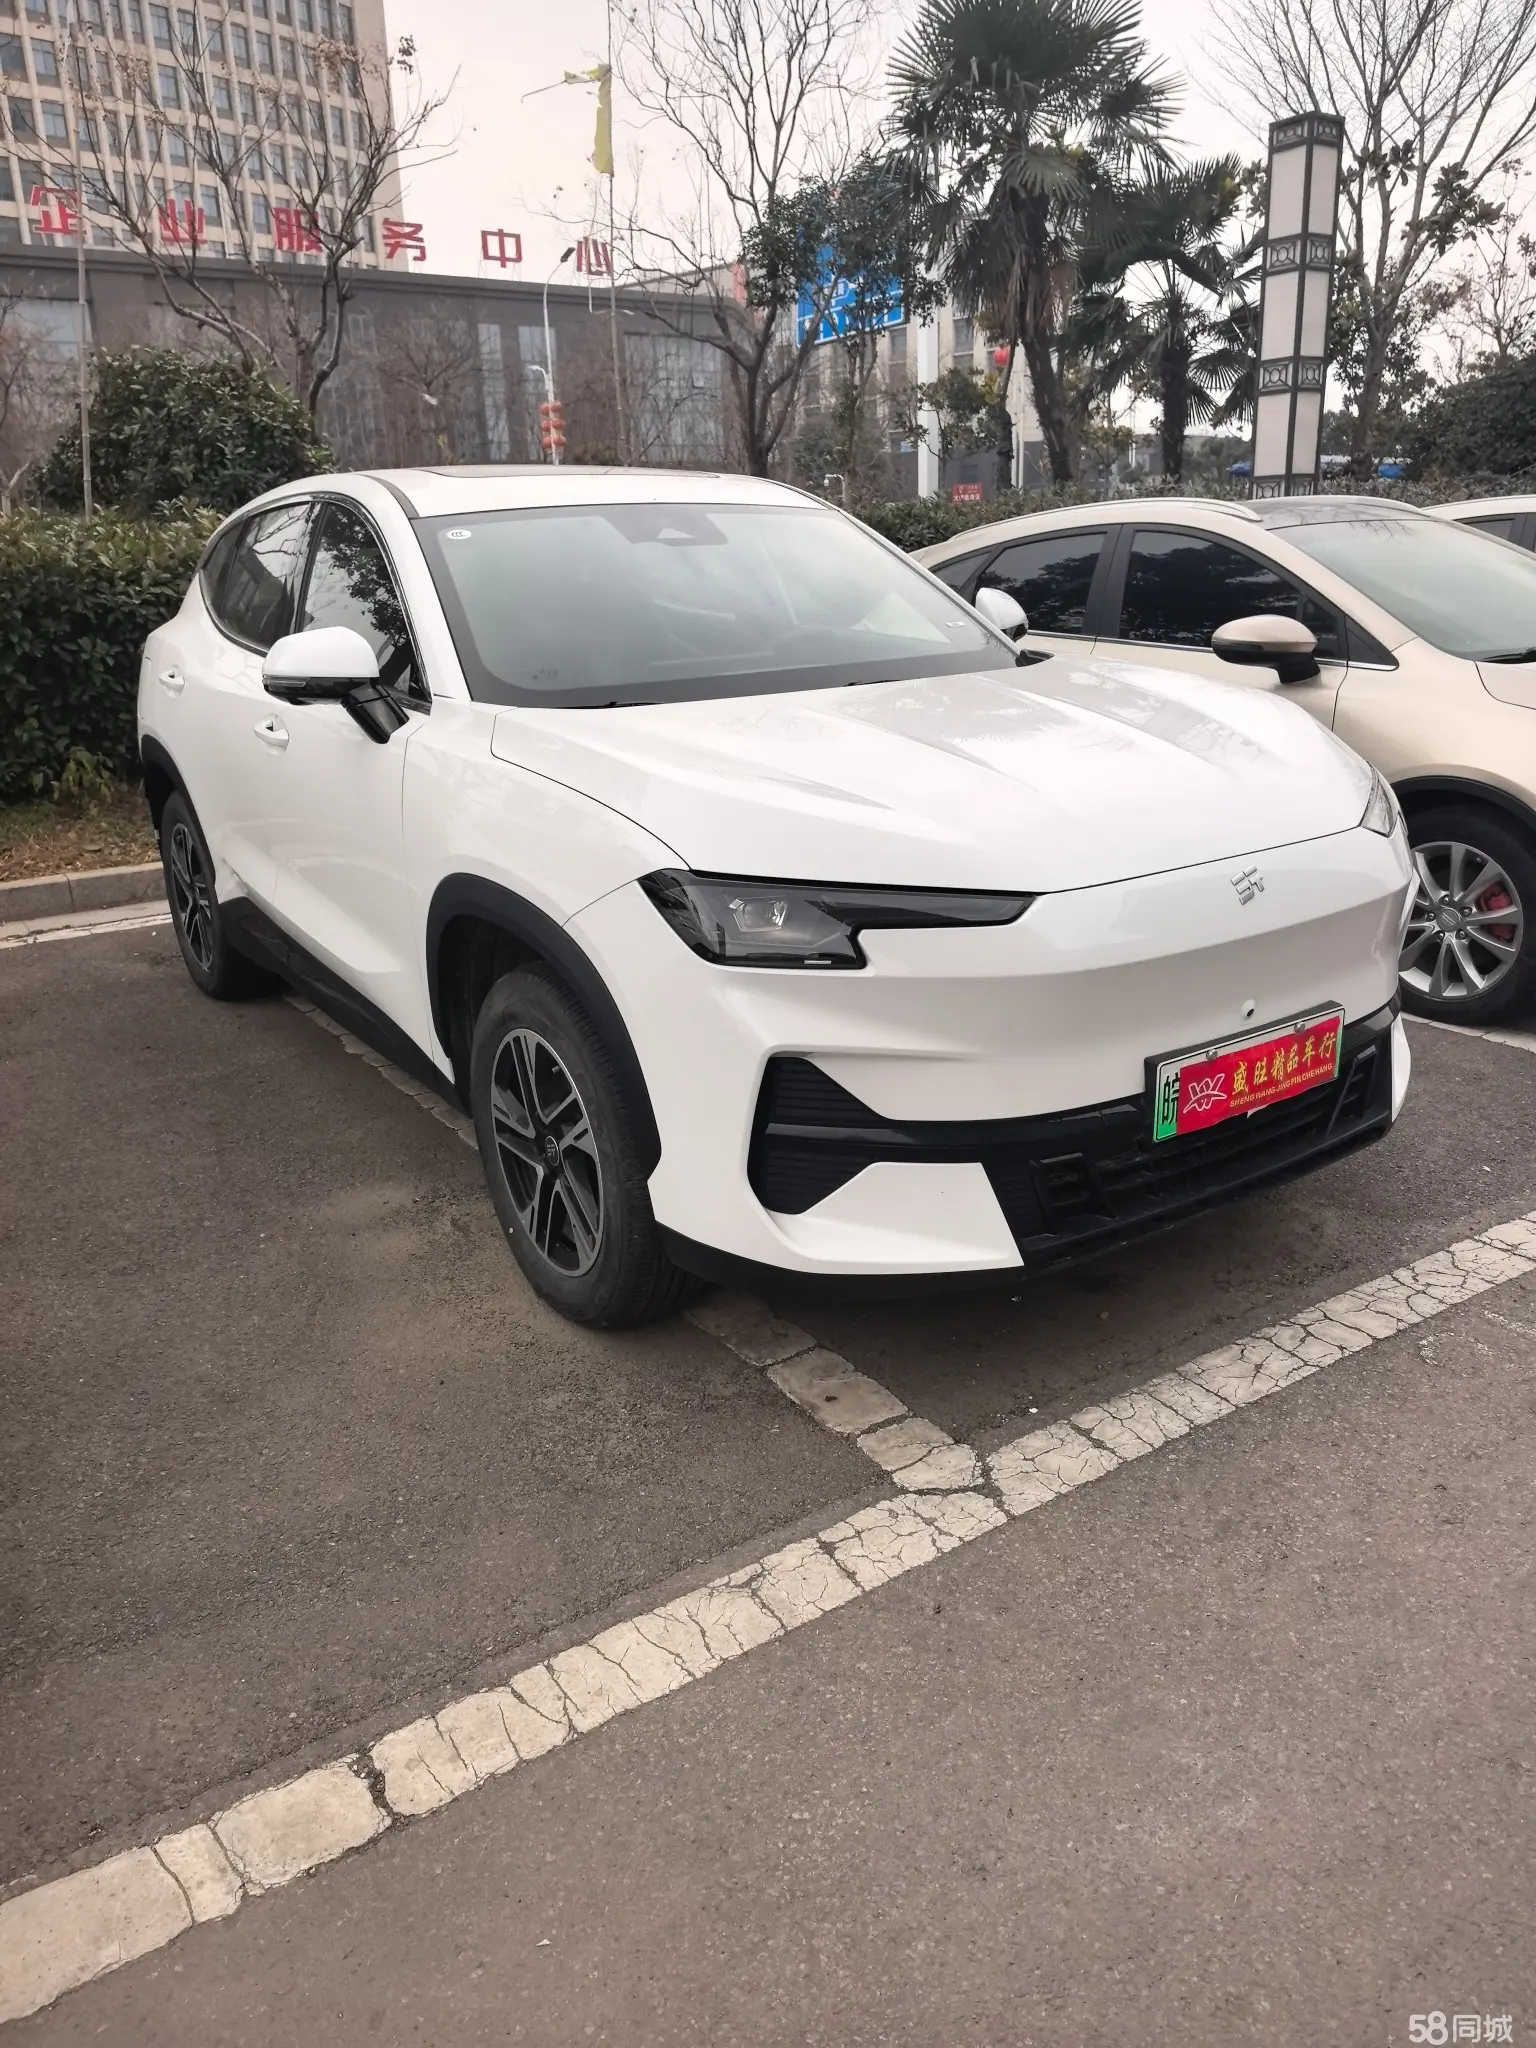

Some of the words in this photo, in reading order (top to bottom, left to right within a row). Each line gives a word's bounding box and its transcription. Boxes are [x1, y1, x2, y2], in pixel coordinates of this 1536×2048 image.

[30, 184, 612, 275] 企业服务中心
[1231, 1031, 1336, 1094] 盛旺精品车行
[1229, 1093, 1255, 1107] SHENG
